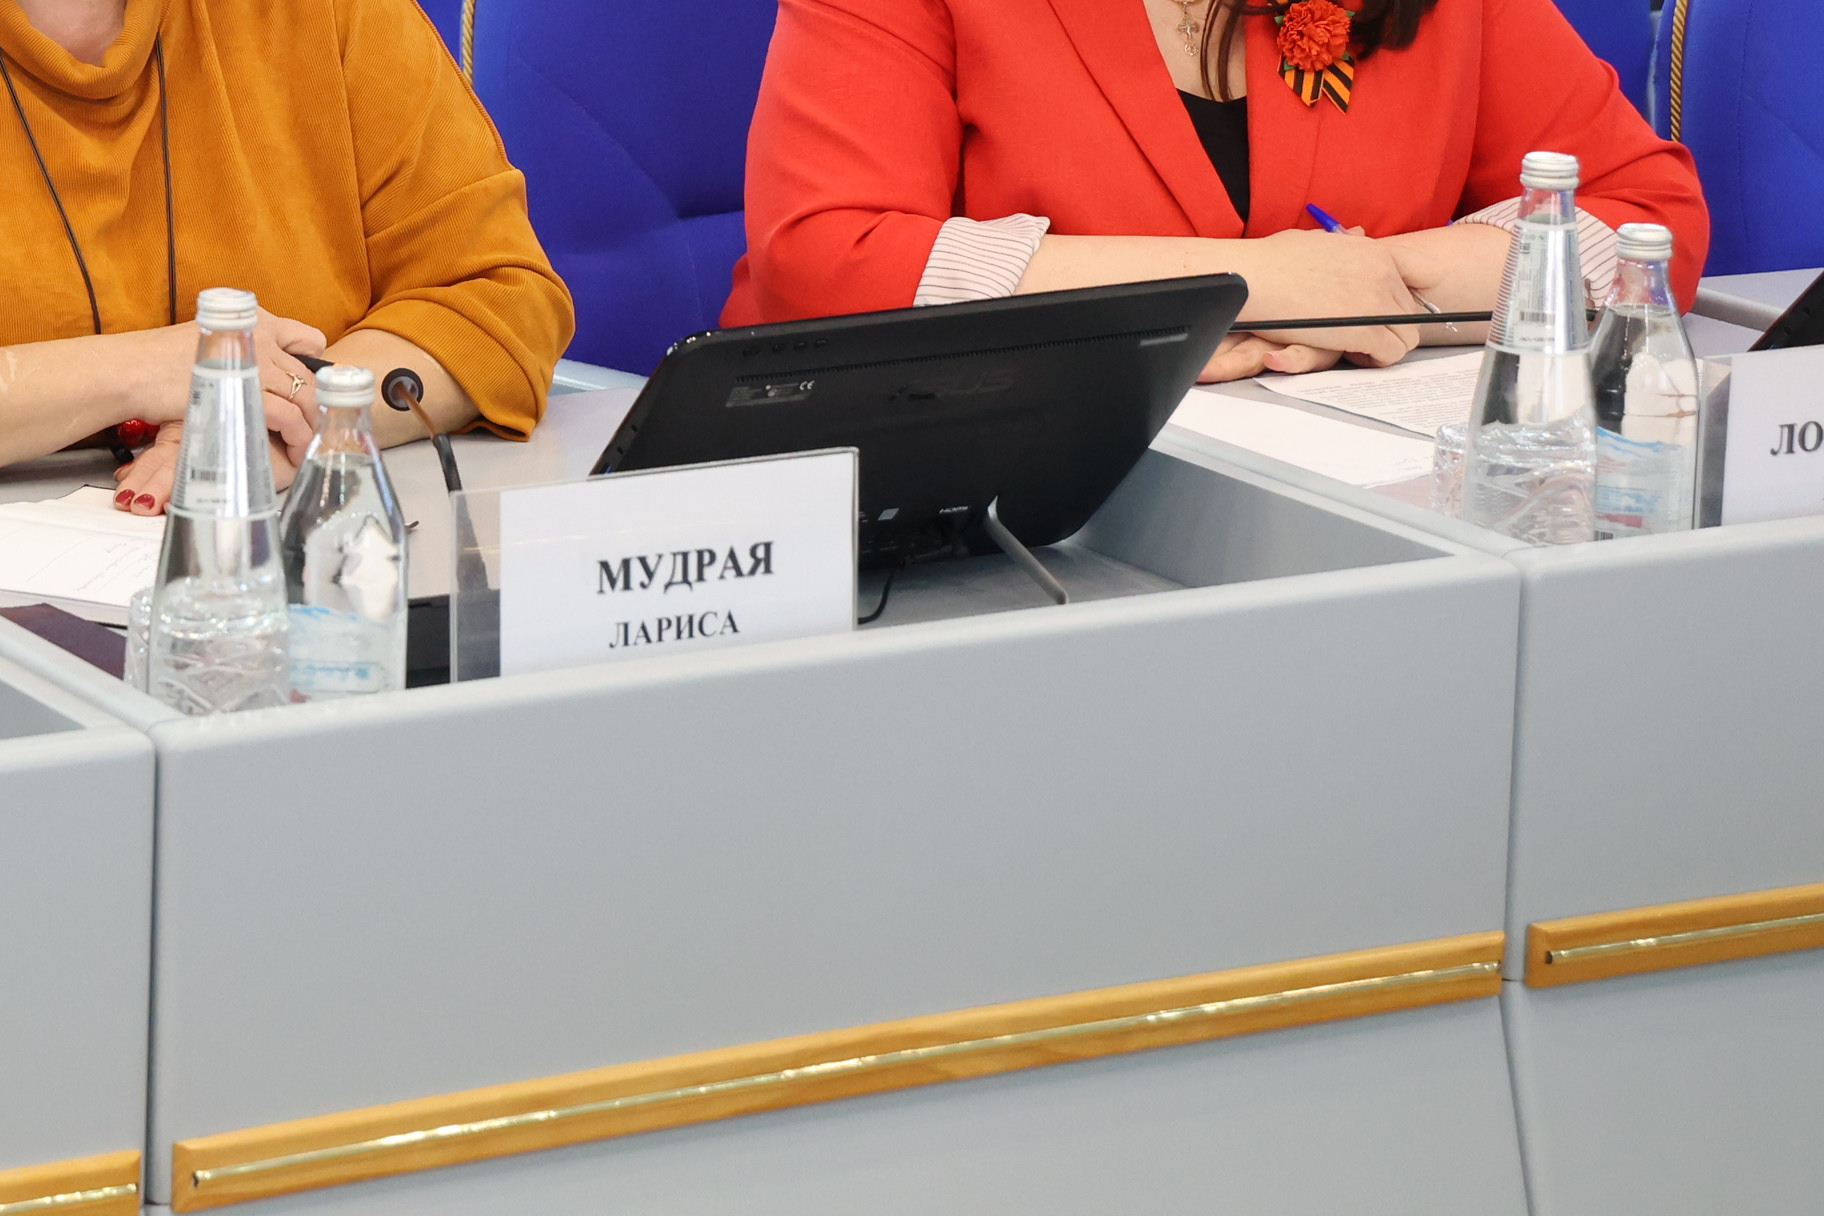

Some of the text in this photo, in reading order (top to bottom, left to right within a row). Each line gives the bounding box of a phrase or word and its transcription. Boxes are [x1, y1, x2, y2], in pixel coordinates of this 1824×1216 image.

[1769, 420, 1824, 456] ЛО
[596, 541, 775, 595] МУДРАЯ
[608, 610, 741, 649] ЛАРИСА
